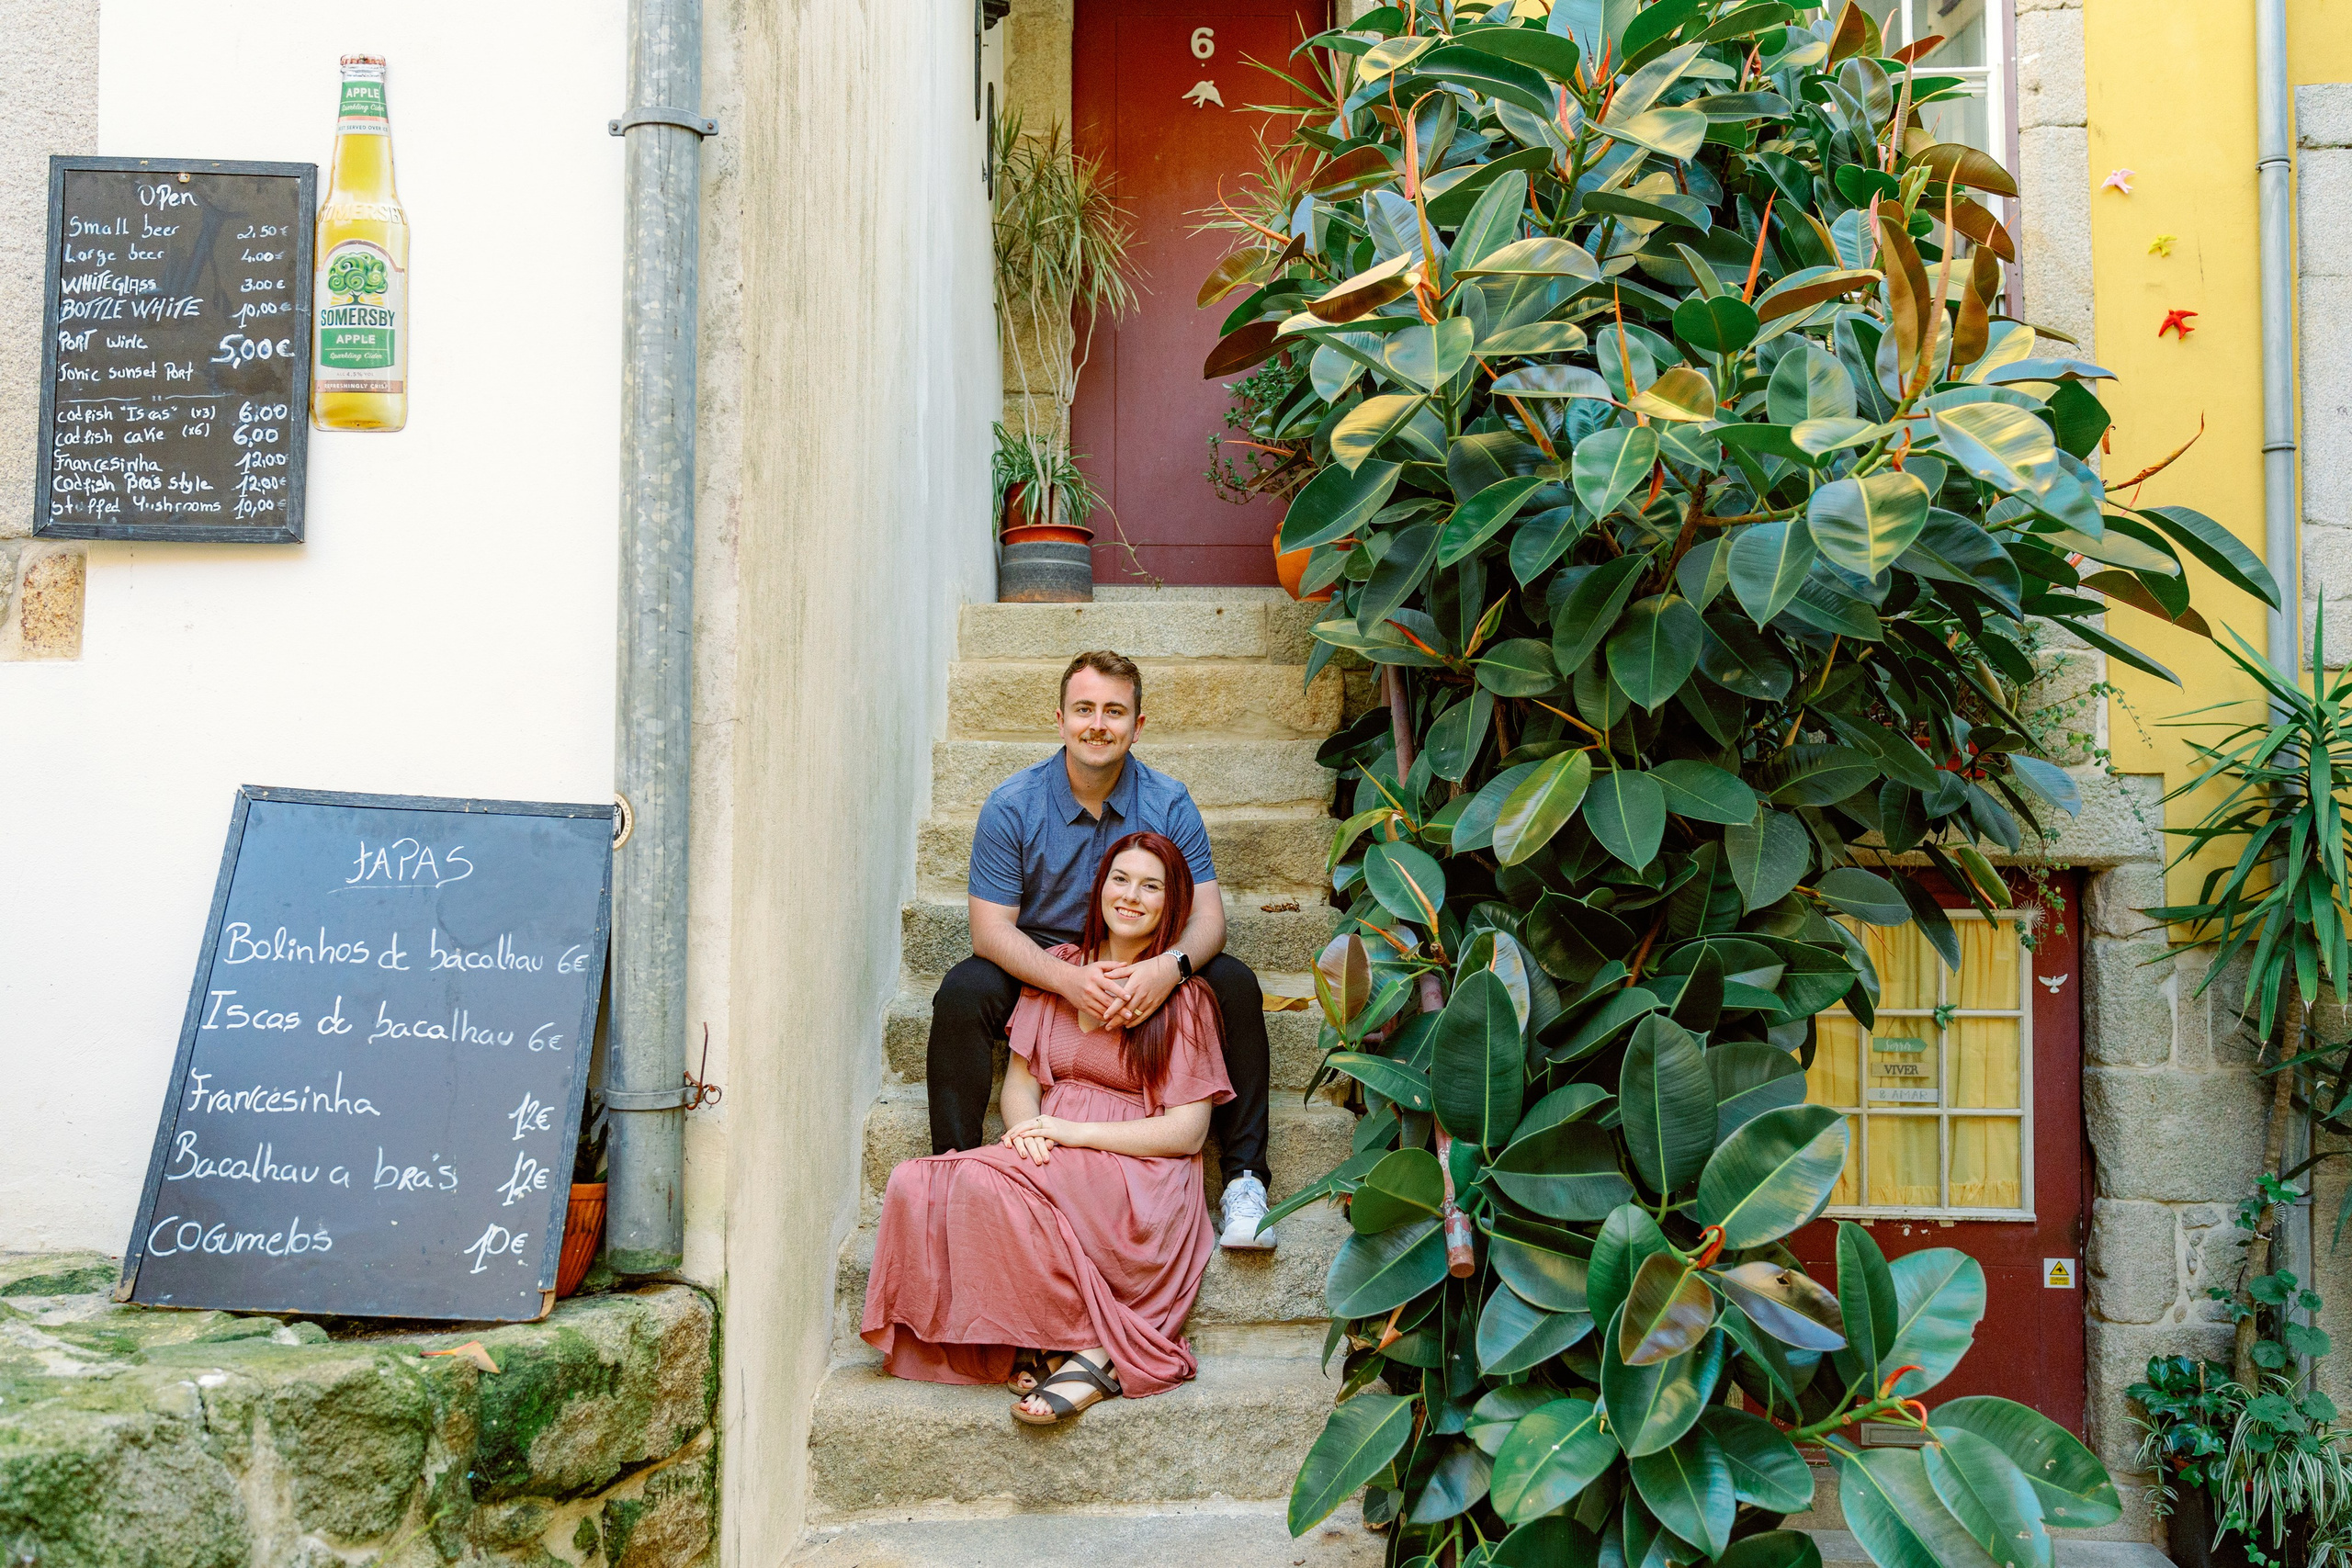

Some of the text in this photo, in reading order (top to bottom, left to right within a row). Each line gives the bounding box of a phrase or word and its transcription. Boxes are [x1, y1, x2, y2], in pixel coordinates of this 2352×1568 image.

[1191, 27, 1215, 60] 6
[345, 87, 380, 98] APPLE
[69, 216, 129, 237] Small
[141, 213, 179, 238] beer
[64, 243, 117, 266] Large
[129, 243, 164, 261] beer
[60, 297, 127, 323] BOTTLE
[321, 308, 395, 327] SOMERSBY
[336, 334, 376, 344] APPLE
[329, 352, 362, 362] Sparkling
[53, 449, 164, 473] Francesinha
[52, 472, 116, 497] Codfish
[167, 471, 214, 494] style
[223, 921, 369, 964] Bolinhos
[428, 928, 544, 973] bacalhau
[558, 944, 590, 975] 6€
[202, 990, 300, 1032] Iscas
[368, 1000, 514, 1046] bacalhau
[528, 1022, 564, 1052] 6€
[1884, 1065, 1918, 1075] VIVER
[187, 1067, 555, 1141] Francesinha 12€
[1892, 1090, 1928, 1100] AMAR
[167, 1131, 319, 1183] Bacalhau
[329, 1166, 350, 1188] a
[497, 1150, 550, 1207] 12€
[463, 1222, 528, 1275] 10€
